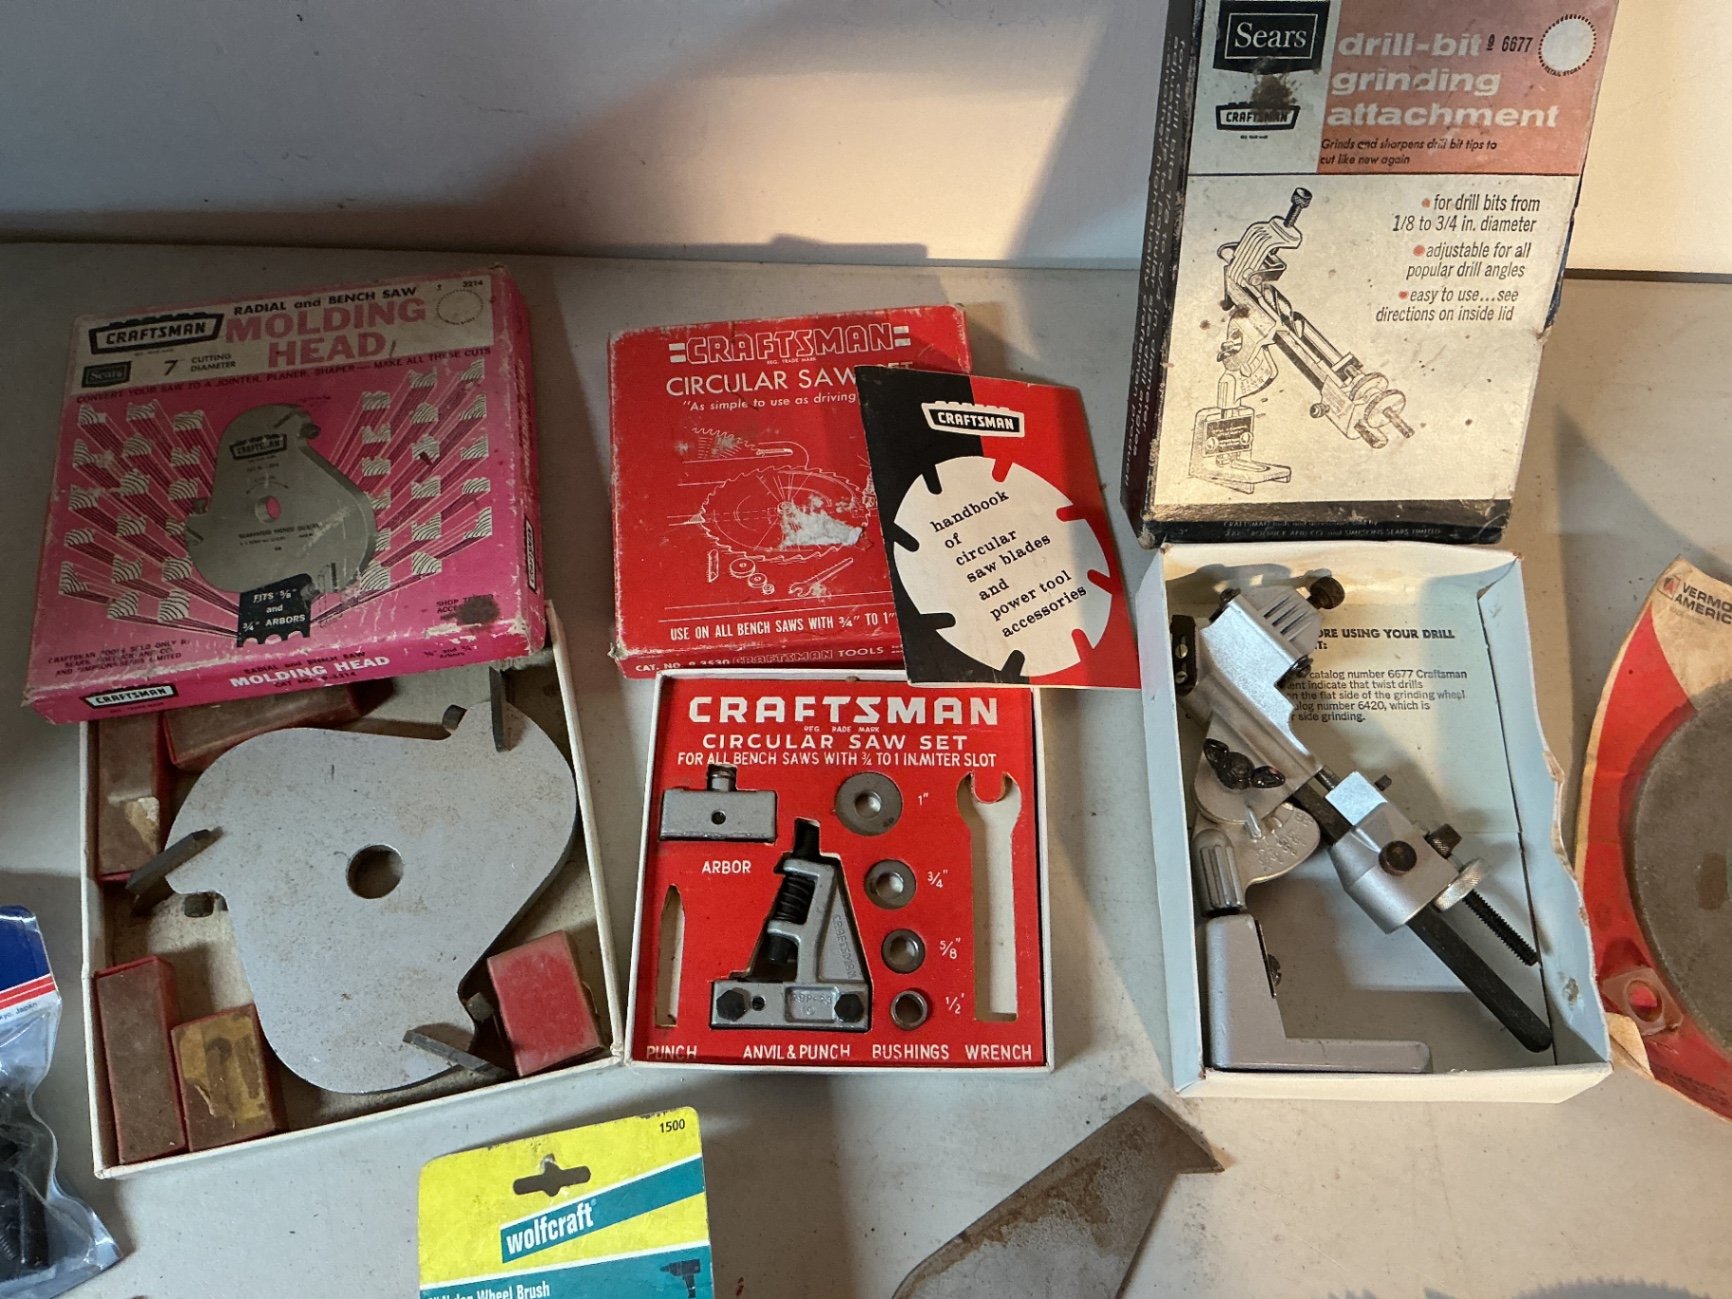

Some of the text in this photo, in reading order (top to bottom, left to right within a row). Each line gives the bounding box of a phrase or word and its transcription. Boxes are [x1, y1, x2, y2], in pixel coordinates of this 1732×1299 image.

[1235, 22, 1307, 48] Sears
[1338, 33, 1482, 56] drill-bit
[1501, 36, 1533, 53] 6677
[1331, 68, 1500, 96] grinding
[1172, 84, 1181, 129] drill
[1326, 102, 1559, 128] attachment
[1321, 138, 1498, 151] Grinds and sharpens drill bit tips to
[1320, 154, 1411, 166] cut like new again
[1433, 194, 1541, 212] for drill bits from
[1392, 214, 1537, 232] 1/8 to 3/4 in. diameter
[1426, 242, 1532, 260] adjustable for all
[1406, 262, 1526, 280] popular drill angles
[234, 287, 416, 316] RADIAL and BENCH SAW
[1409, 289, 1439, 305] easy
[1441, 287, 1454, 301] to
[226, 297, 426, 343] MOLDING
[1375, 306, 1515, 322] directions on inside lid
[105, 321, 208, 346] CRAFTSMAN
[267, 331, 387, 368] HEAD
[686, 323, 894, 364] CRAFTSMAN
[190, 361, 236, 373] DIAMETER
[191, 353, 232, 364] CUTTING
[666, 366, 858, 396] CIRCULAR SAW
[710, 391, 857, 412] simple to use as driving
[938, 411, 1014, 430] CRAFTSMAN
[930, 491, 1009, 532] handbook
[945, 532, 962, 548] of
[956, 530, 1017, 566] circular
[967, 534, 1051, 583] saw blades
[253, 592, 274, 603] FITS
[979, 578, 1009, 601] and
[990, 569, 1072, 622] power tool
[266, 604, 283, 614] and
[1002, 586, 1087, 637] accessories
[1675, 594, 1732, 624] AMERIC
[265, 613, 306, 628] ARBORS
[670, 613, 878, 641] USE ON ALL BENCH SAWS WITH TO
[1342, 629, 1380, 638] USING
[1384, 628, 1419, 639] YOUR
[1423, 629, 1456, 639] DRILL
[730, 646, 885, 665] CRAFTSMAN TOOLS
[230, 665, 328, 688] MOLDING
[334, 656, 391, 672] HEAD
[635, 664, 660, 672] CAT.
[1310, 669, 1468, 680] catalog number 6677 Craftsman
[1308, 680, 1347, 689] indicate
[1350, 680, 1369, 689] that
[1372, 680, 1396, 689] twist
[1398, 680, 1423, 689] drills
[95, 687, 166, 704] CRAFTSMAN
[1301, 691, 1318, 700] the
[1320, 690, 1336, 700] flat
[1339, 690, 1360, 700] side
[1362, 690, 1373, 699] of
[1374, 690, 1391, 700] the
[1394, 690, 1435, 701] grinding
[1436, 689, 1466, 700] wheel
[689, 696, 998, 725] CRAFTSMAN
[1317, 701, 1355, 710] number
[1358, 701, 1387, 711] 6420,
[1389, 701, 1418, 711] which
[1421, 701, 1431, 710] is
[1299, 712, 1319, 721] side
[1321, 712, 1366, 723] grinding.
[702, 733, 968, 750] CIRCULAR SAW SET
[677, 751, 997, 767] FOR ALL BENCH SAWS WITH TO 1 SLOT
[701, 860, 751, 875] ARBOR
[648, 1044, 697, 1060] PUNCH
[743, 1044, 850, 1060] ANVIL & PUNCH
[873, 1044, 950, 1061] BUSHINGS
[965, 1044, 1032, 1061] WRENCH
[659, 1118, 685, 1133] 1500
[506, 1202, 594, 1255] wolfcraft
[477, 1286, 512, 1299] Wheel
[516, 1280, 550, 1298] Brush
